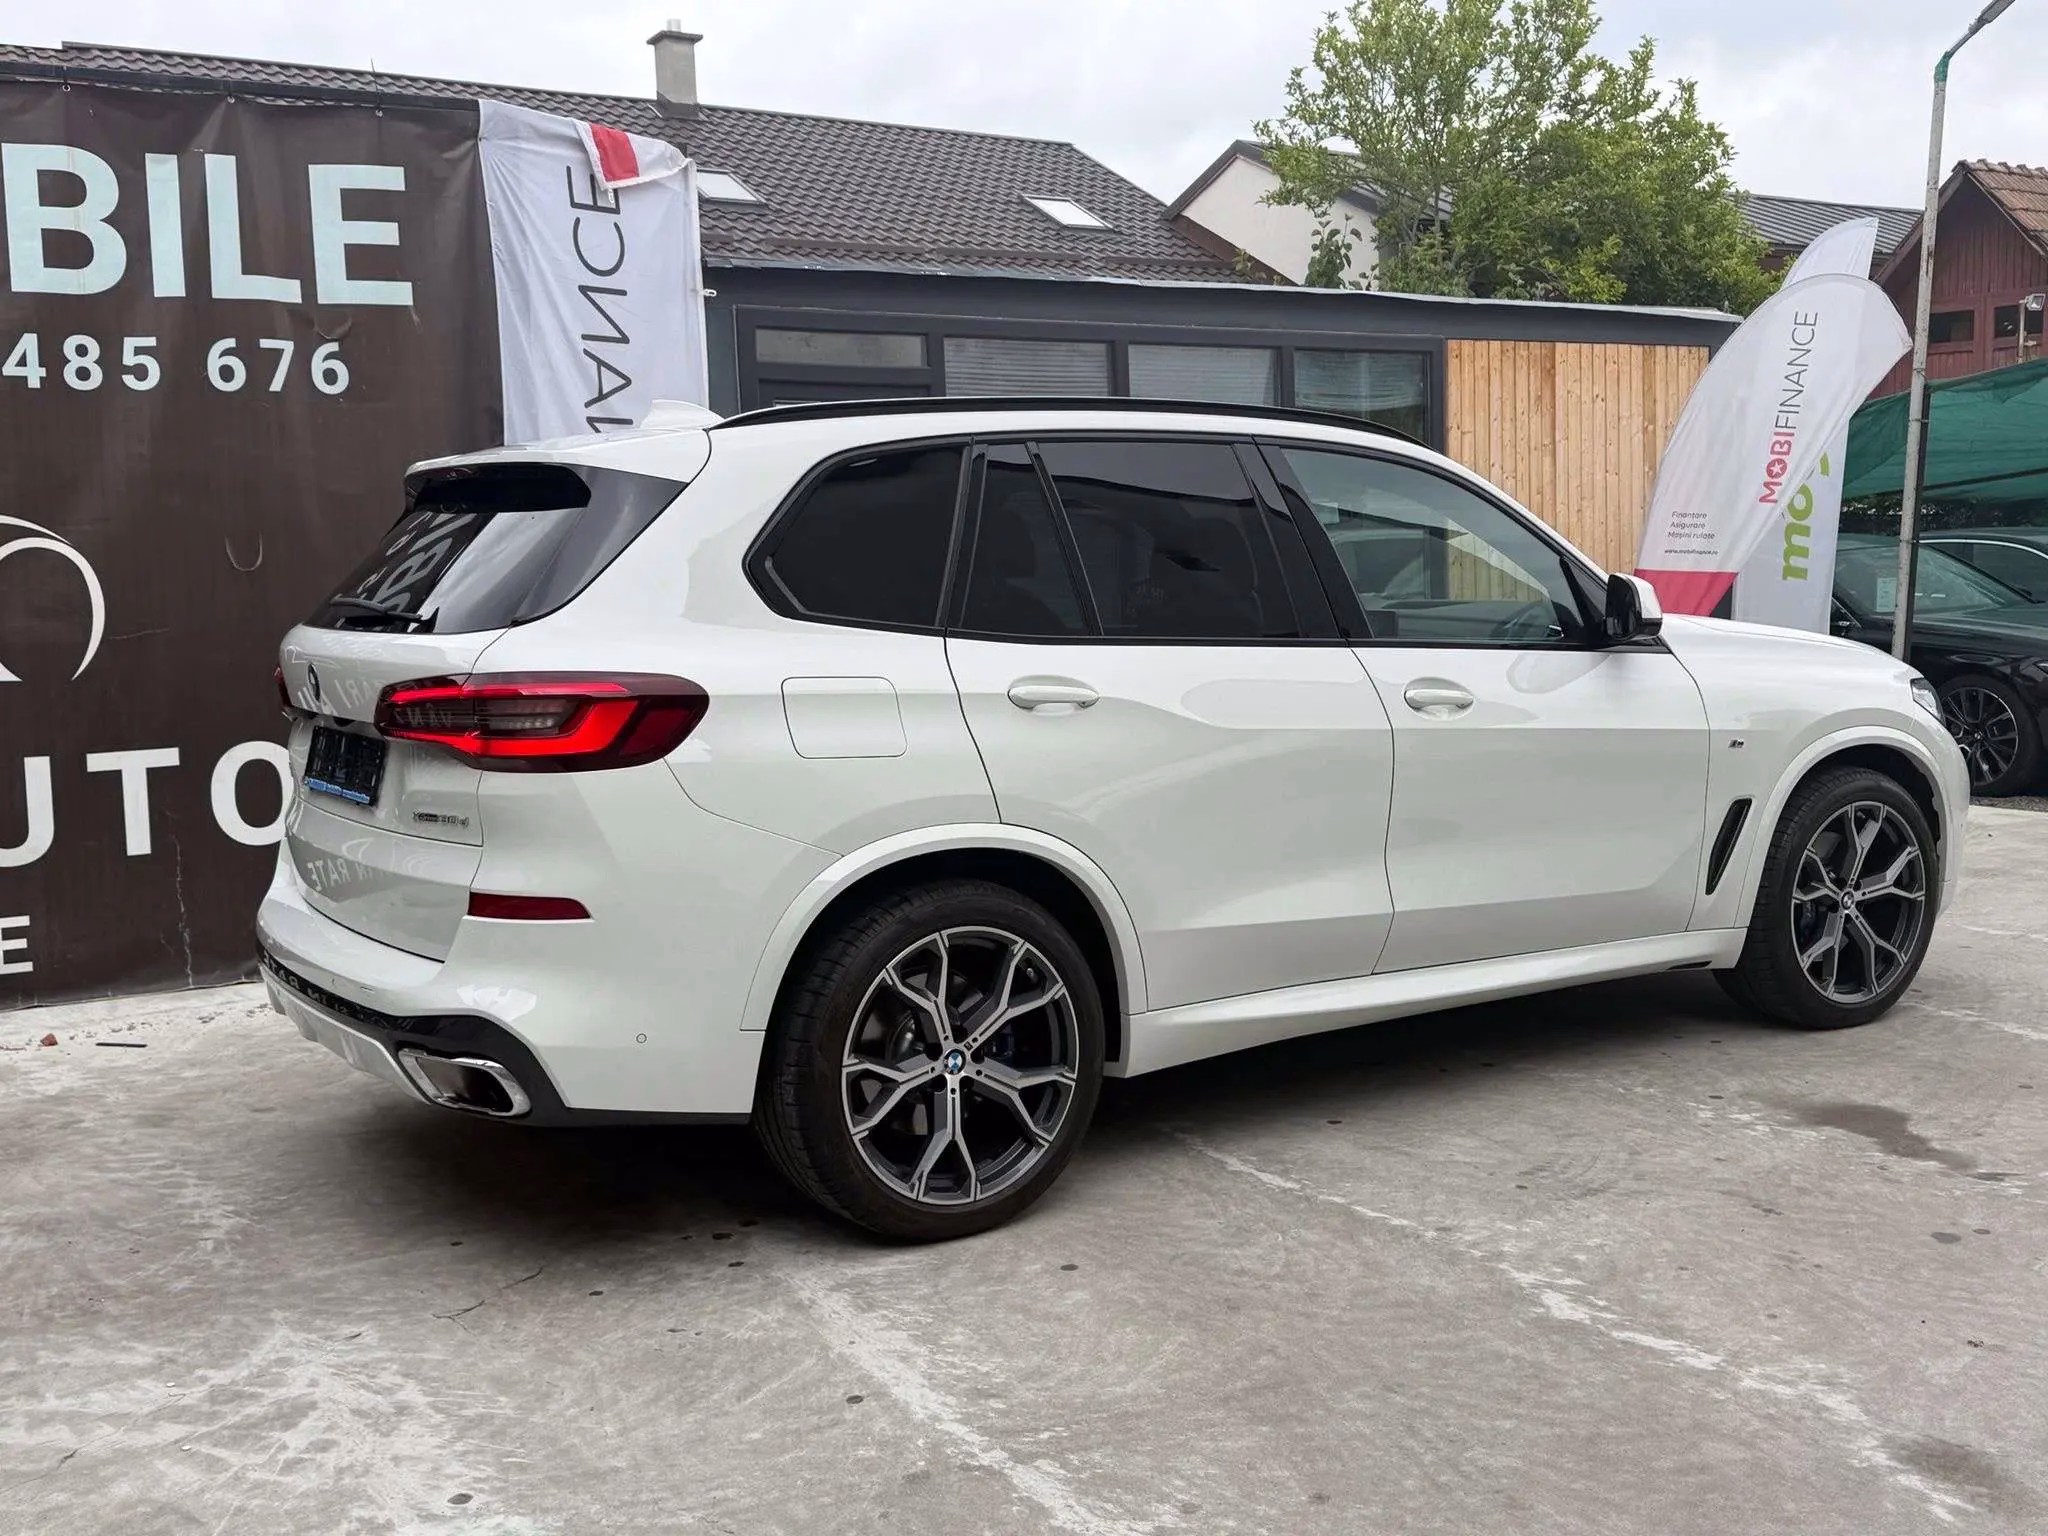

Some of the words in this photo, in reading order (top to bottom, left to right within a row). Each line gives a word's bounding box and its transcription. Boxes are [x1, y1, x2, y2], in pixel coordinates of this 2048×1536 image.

[1, 143, 414, 306] BILE
[1, 333, 161, 391] 485
[206, 337, 350, 395] 676
[1758, 311, 1819, 504] MOBIFINANCE
[1671, 521, 1706, 530] Asigurare
